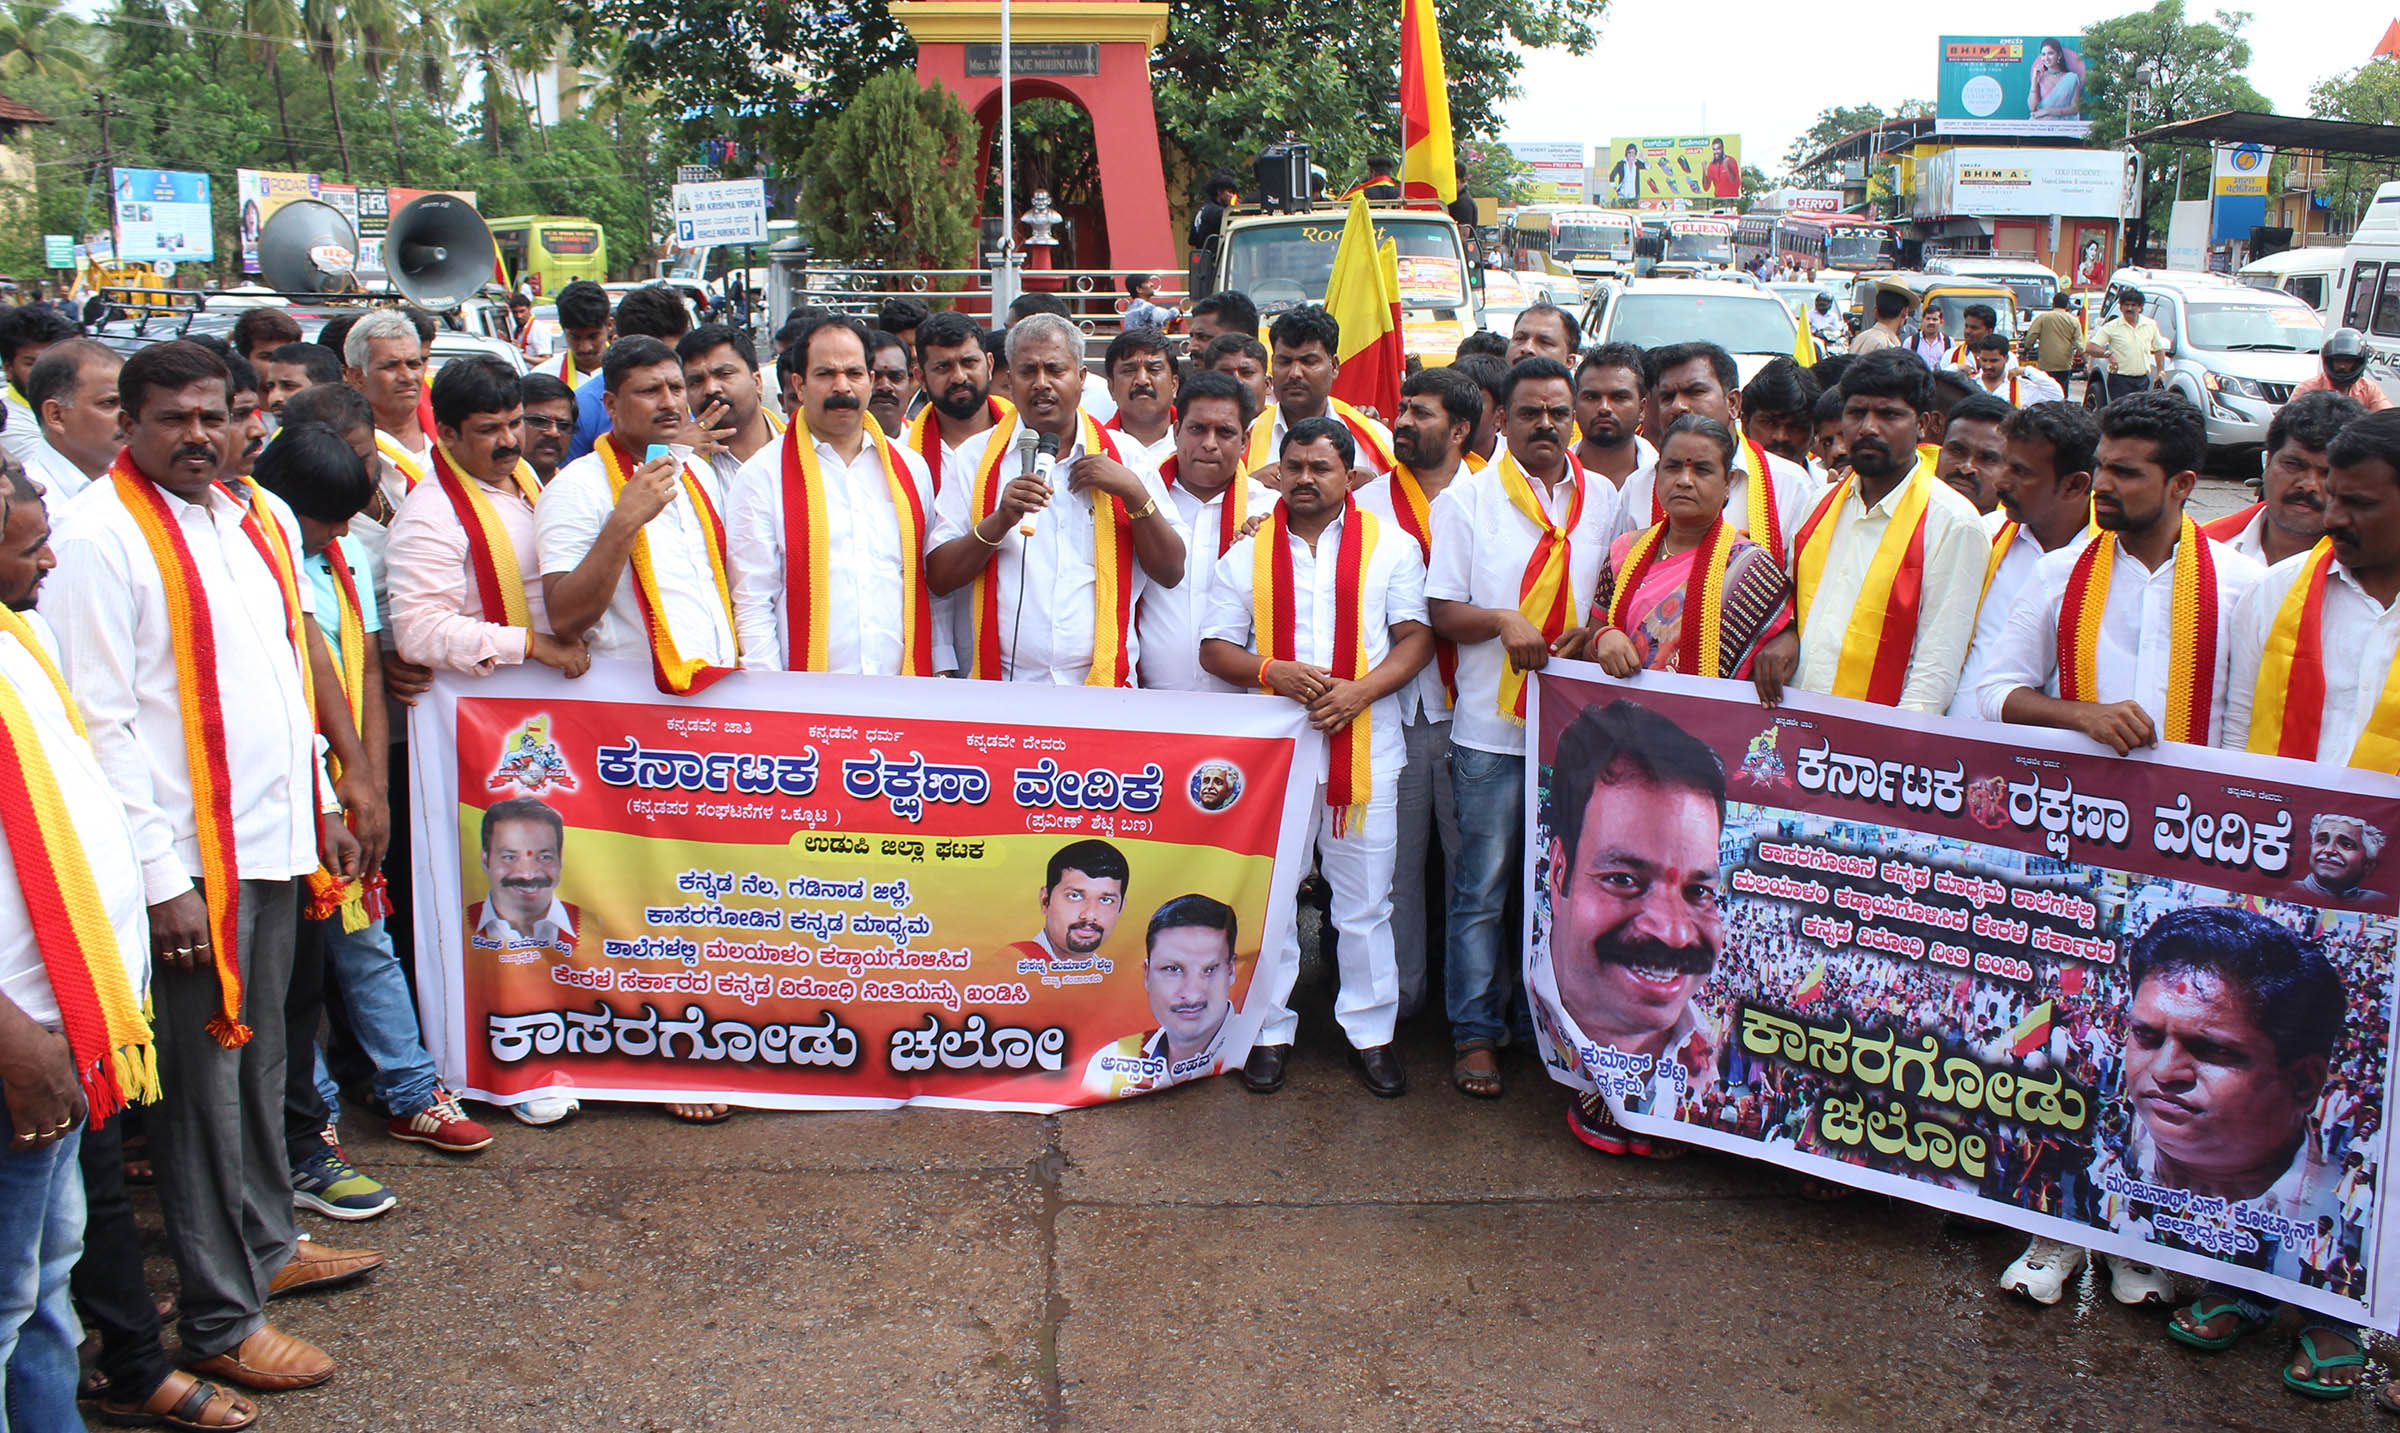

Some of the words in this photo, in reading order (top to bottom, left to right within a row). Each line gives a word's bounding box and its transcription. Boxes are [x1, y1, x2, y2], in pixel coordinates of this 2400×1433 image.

[1963, 170, 2018, 178] BHIMA
[737, 199, 762, 208] TEMPLE
[1796, 199, 1835, 210] SERVO
[1672, 222, 1729, 235] CELIENA
[666, 718, 717, 738] ಕನ್ನಡವೇ
[723, 721, 753, 735] ಜಾತಿ
[808, 725, 858, 746] ಕನ್ನಡವೇ
[865, 728, 904, 742] ಧರ್ಮ
[966, 733, 1016, 754] ಕನ್ನಡವೇ
[1022, 735, 1067, 752] ದೇವರು
[596, 736, 819, 797] ಕರ್ನಾಟಕ
[843, 748, 991, 823] ರಕ್ಷಣಾ
[1013, 757, 1163, 813] ವೇದಿಕೆ
[695, 803, 774, 821] ಸಂಘಟನೆಗಳ
[1796, 736, 1964, 813] ಕರ್ನಾಟಕ
[2008, 771, 2130, 861] ರಕ್ಷಣಾ
[2153, 794, 2292, 872] ವೇದಿಕೆ
[1091, 814, 1117, 837] ಶೆಟ್ಟಿ
[804, 835, 870, 856] ಉಡುಪಿ
[880, 838, 925, 864] ಜಿಲ್ಲಾ
[935, 840, 985, 860] ಘಟಕ
[678, 871, 733, 901] ಕನ್ನಡ
[741, 874, 779, 898] ನೆಲ,
[788, 876, 864, 901] ಗಡಿನಾಡ
[1758, 842, 1877, 878] ಕಾಸರಗೋಡಿನ
[1881, 863, 1930, 894] ಕನ್ನಡ
[1934, 871, 2006, 909] ಮಾಧ್ಯಮ
[2012, 886, 2097, 929] ಶಾಲೆಗಳಲ್ಲಿ
[646, 905, 782, 932] ಕಾಸರಗೋಡಿನ
[790, 911, 844, 941] ಕನ್ನಡ
[853, 916, 931, 945] ಮಾಧ್ಯಮ
[1732, 870, 1828, 904] ಮಲಯಾಳಂ
[1834, 886, 1970, 932] ಕಡ್ಡಾಯಗೊಳಿಸಿದ
[1974, 914, 2028, 944] ಕೇರಳ
[2032, 927, 2116, 965] ಸರ್ಕಾರದ
[604, 939, 698, 972] ಶಾಲೆಗಳಲ್ಲಿ
[705, 942, 810, 967] ಮಲಯಾಳಂ
[1802, 915, 1853, 949] ಕನ್ನಡ
[1857, 925, 1925, 959] ವಿರೋಧಿ
[1930, 941, 1971, 967] ನೀತಿ
[1976, 953, 2033, 983] ಖಂಡಿಸಿ
[552, 965, 612, 992] ಕೇರಳ
[620, 971, 709, 995] ಸರ್ಕಾರದ
[716, 973, 771, 1006] ಕನ್ನಡ
[779, 976, 857, 1004] ವಿರೋಧಿ
[863, 979, 962, 1013] ನೀತಿಯನ್ನು
[965, 982, 1030, 1005] ಖಂಡಿಸಿ
[487, 999, 859, 1069] ಕಾಸರಗೋಡು
[889, 1011, 1066, 1072] ಚಲೋ
[1580, 1043, 1651, 1074] ಕುಮಾರ್
[1656, 1057, 1687, 1094] ಶೆಟ್ಟಿ
[1743, 1008, 2087, 1131] ಕಾಸರಗೋಡು
[1821, 1092, 1987, 1178] ಚಲೋ
[2154, 1213, 2259, 1253] ಜಿಲ್ಲಾಧ್ಯಕ್ಷರು
[2233, 1201, 2317, 1250] ಕೋಟ್ಯಾನ್
